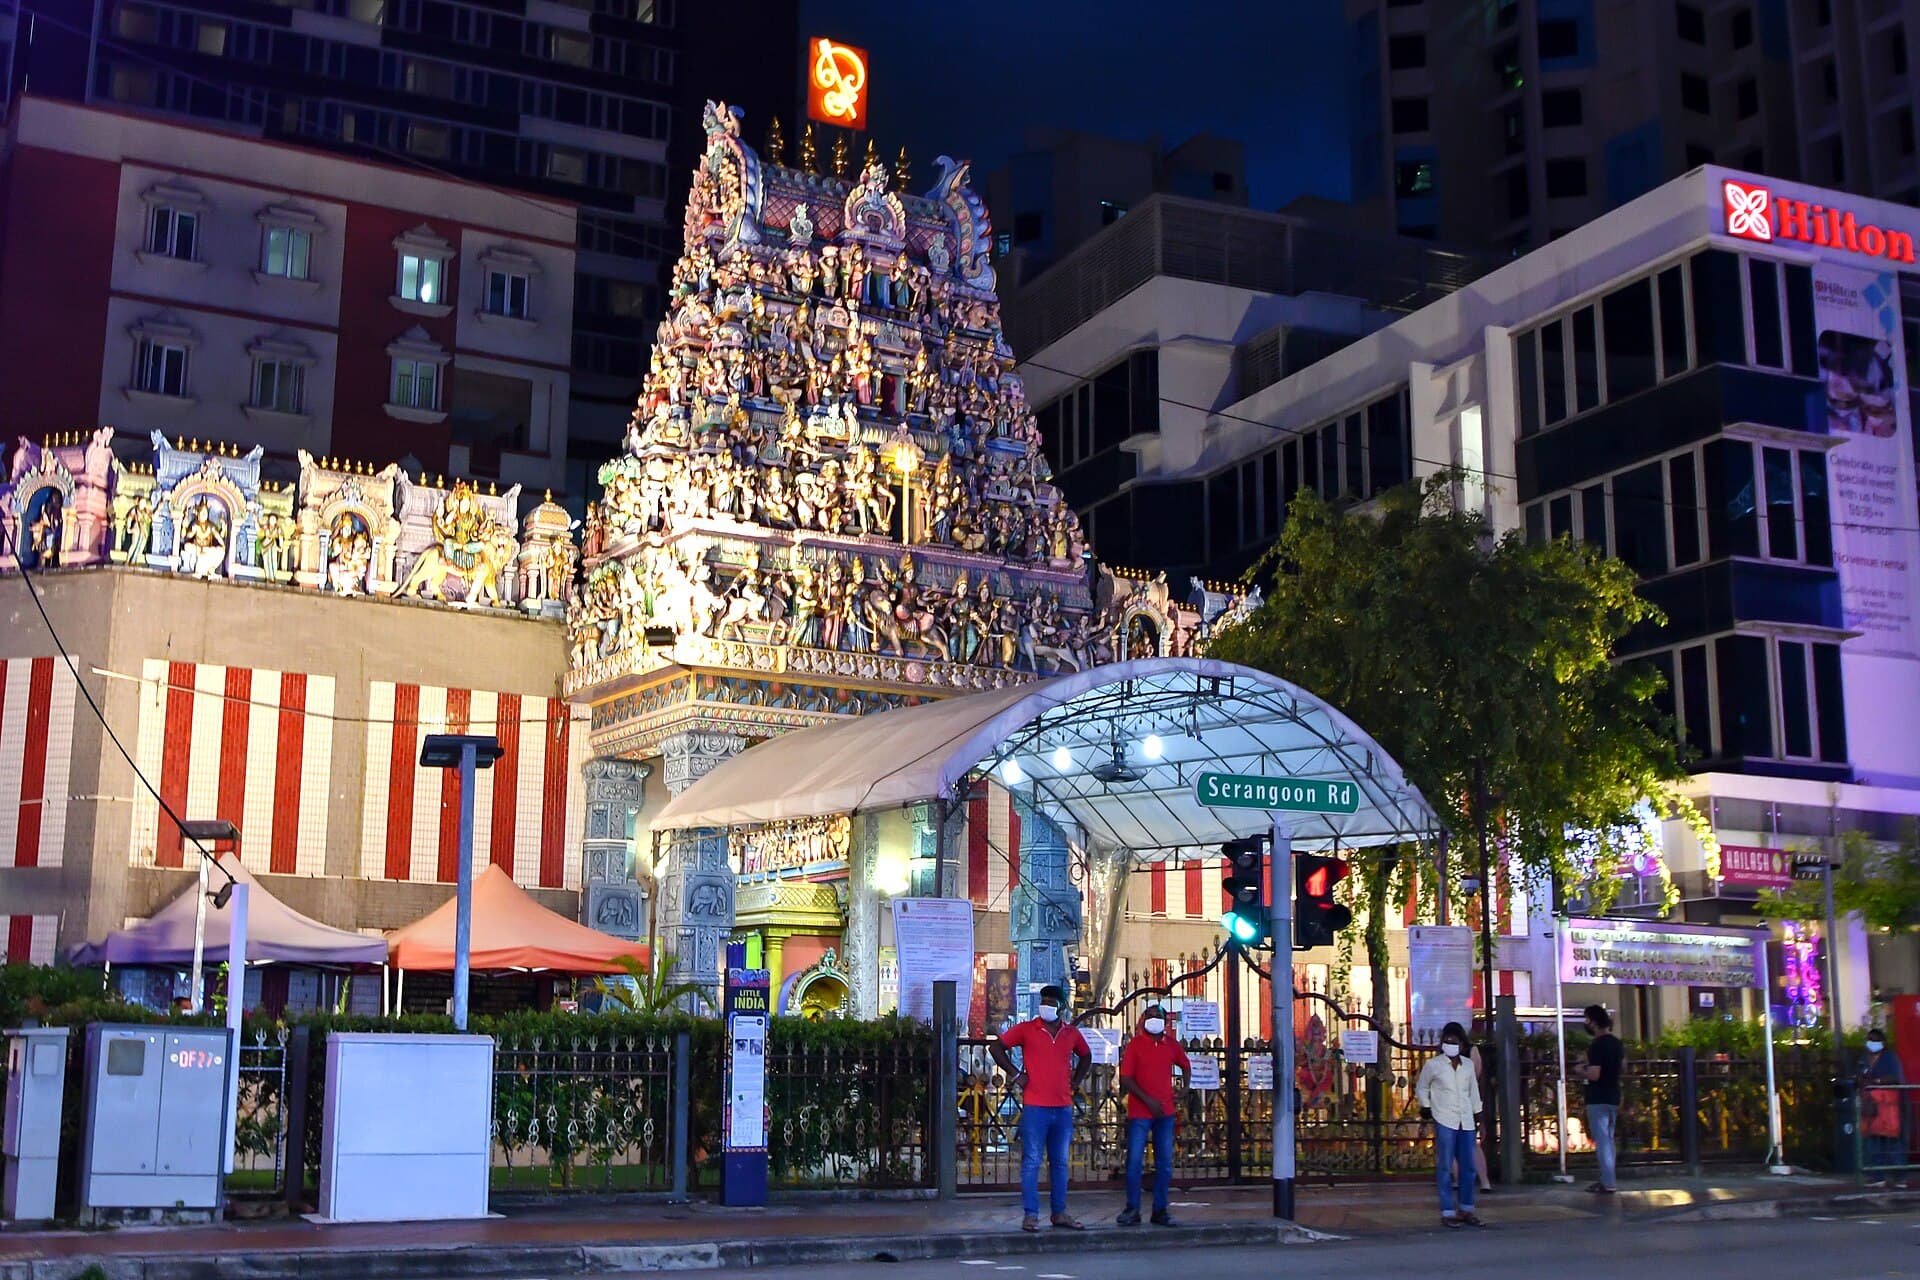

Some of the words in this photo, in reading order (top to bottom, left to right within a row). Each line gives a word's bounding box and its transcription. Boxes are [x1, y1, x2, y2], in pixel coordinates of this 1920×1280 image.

[1776, 197, 1915, 263] Hilton
[1208, 776, 1316, 805] Serangoon
[1328, 784, 1350, 805] Rd
[734, 997, 766, 1010] INDIA
[739, 989, 760, 997] LITTLE
